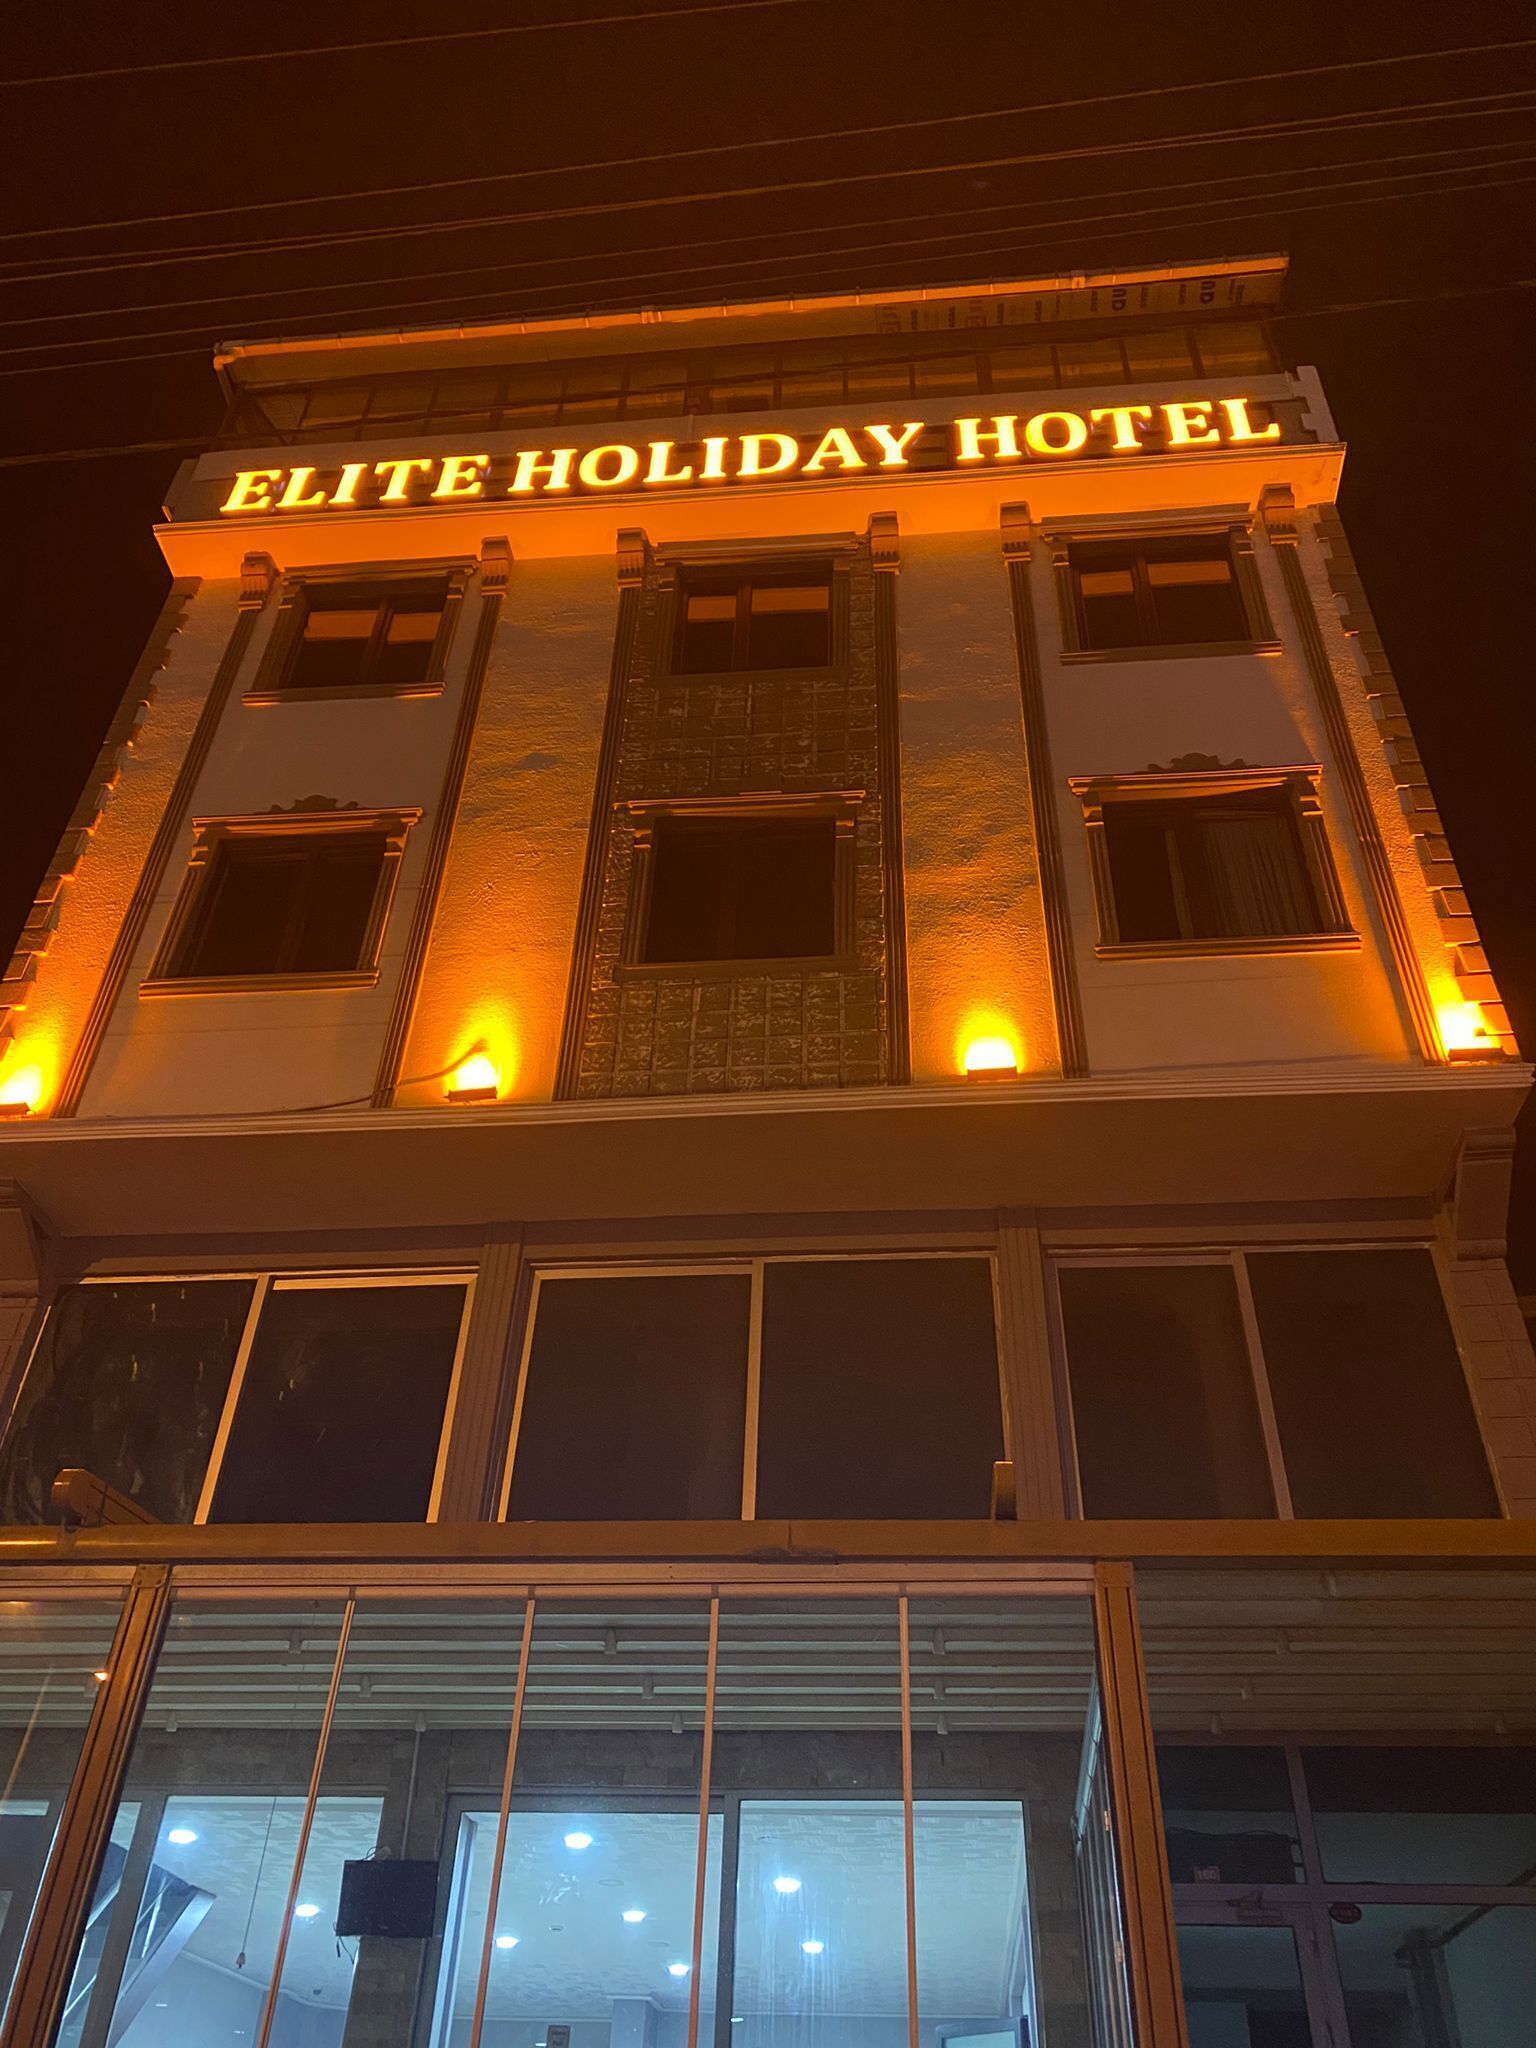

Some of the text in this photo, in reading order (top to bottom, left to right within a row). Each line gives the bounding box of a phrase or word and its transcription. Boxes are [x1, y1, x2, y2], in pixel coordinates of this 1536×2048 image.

[218, 397, 1282, 514] ELITE HOLIDAY HOTEL
